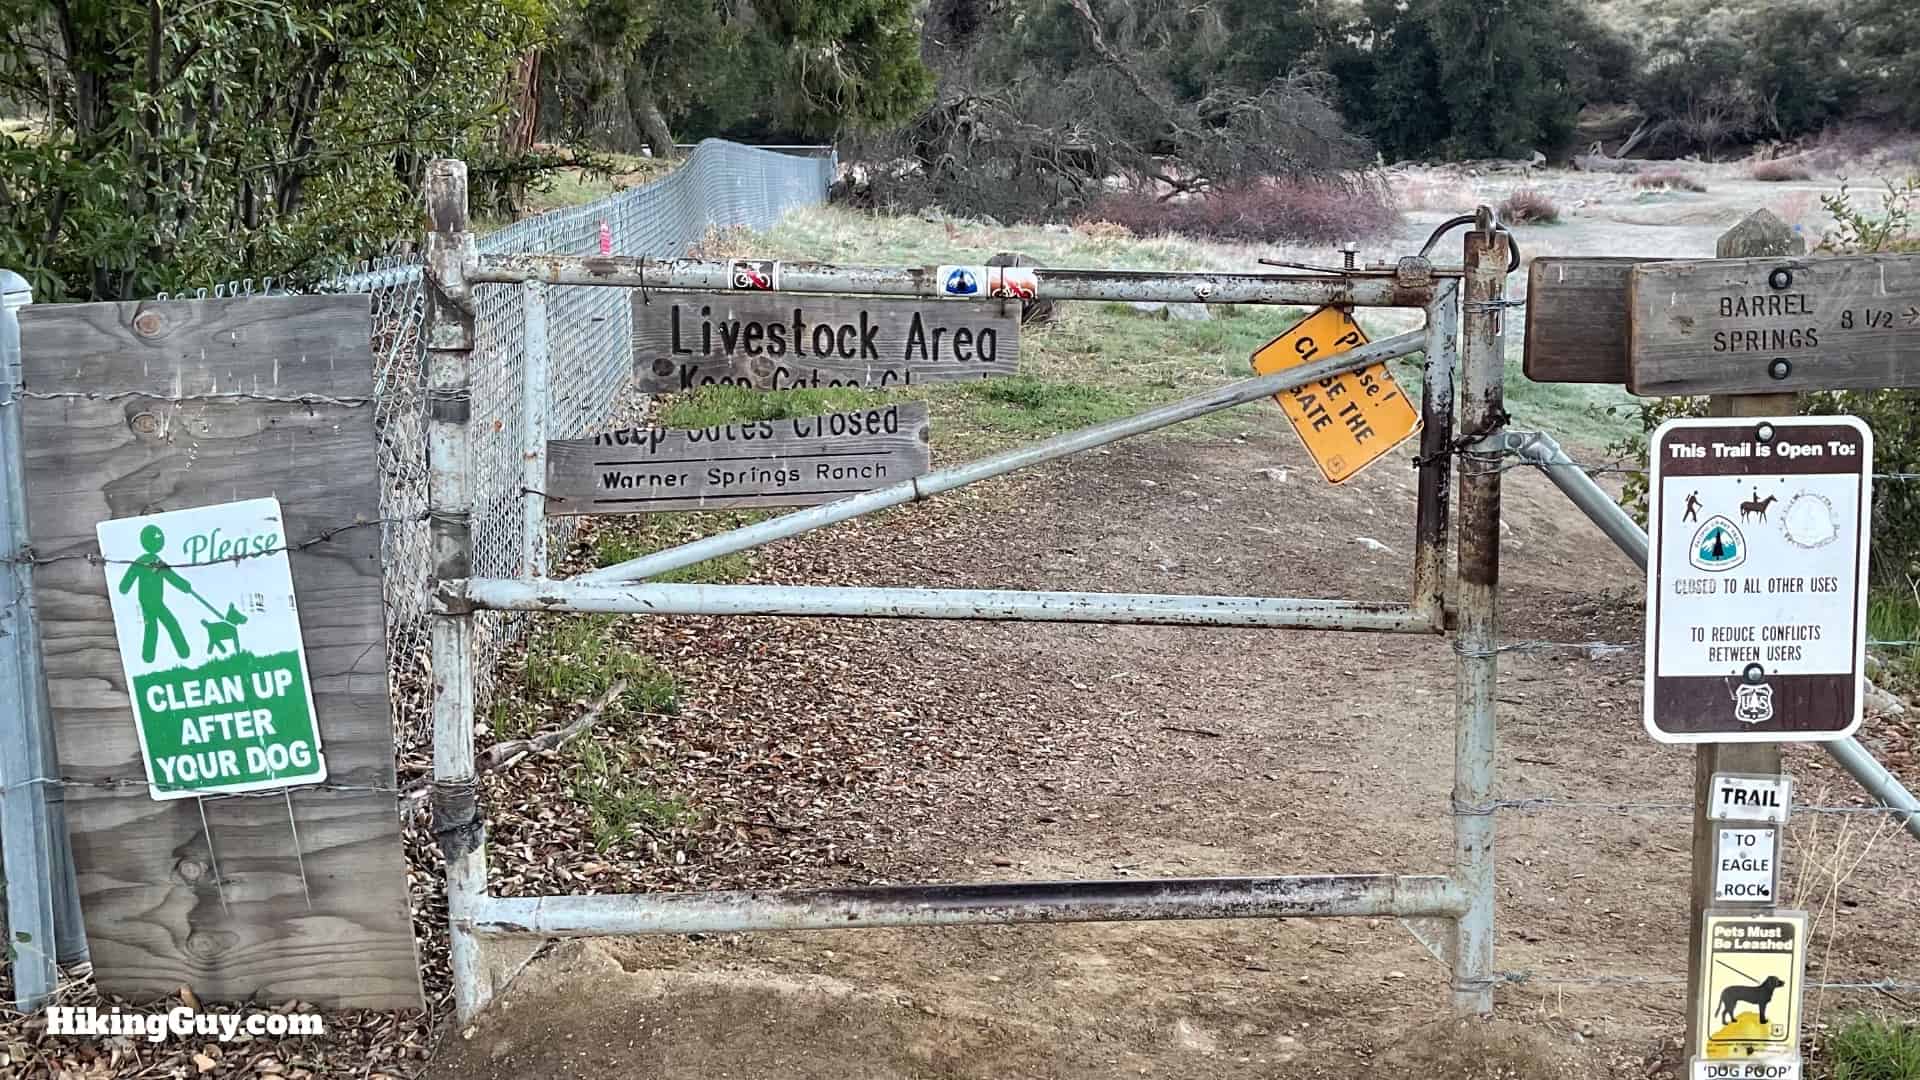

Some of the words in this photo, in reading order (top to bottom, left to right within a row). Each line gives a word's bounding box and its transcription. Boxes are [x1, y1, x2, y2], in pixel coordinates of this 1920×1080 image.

[1719, 294, 1813, 318] BARREL
[671, 304, 879, 360] Livestock
[905, 311, 997, 363] Area
[1713, 328, 1819, 352] SPRINGS
[1294, 337, 1347, 401] CLSE
[1338, 401, 1375, 446] THE
[1669, 443, 1707, 459] This
[1712, 442, 1751, 458] Trail
[1755, 442, 1770, 458] is
[1776, 442, 1823, 460] Open
[1827, 440, 1856, 456] To:
[602, 471, 688, 489] Warner
[707, 467, 800, 488] Springs
[815, 463, 887, 481] Ranch
[183, 528, 280, 564] Please
[1675, 579, 1717, 595] CLOSED
[1723, 578, 1737, 594] TO
[1743, 577, 1762, 594] ALL
[1768, 577, 1804, 594] OTHER
[1810, 577, 1838, 593] USES
[1691, 627, 1704, 642] TO
[1712, 626, 1755, 642] REDUCE
[1762, 625, 1821, 641] CONFLICTS
[1709, 646, 1760, 662] BETWEEN
[1767, 646, 1802, 661] USERS
[146, 671, 245, 713] CLEAN
[251, 668, 293, 700] UP
[180, 708, 276, 745] AFTER
[156, 747, 239, 784] YOUR
[246, 740, 312, 774] DOG
[1721, 787, 1780, 808] TRAIL
[1735, 833, 1756, 848] TO
[1721, 858, 1769, 872] EAGLE
[1724, 883, 1766, 897] ROCK
[1714, 925, 1745, 939] Pets
[1747, 925, 1782, 938] Must
[1713, 938, 1732, 950] Be
[1734, 937, 1793, 950] Leashed
